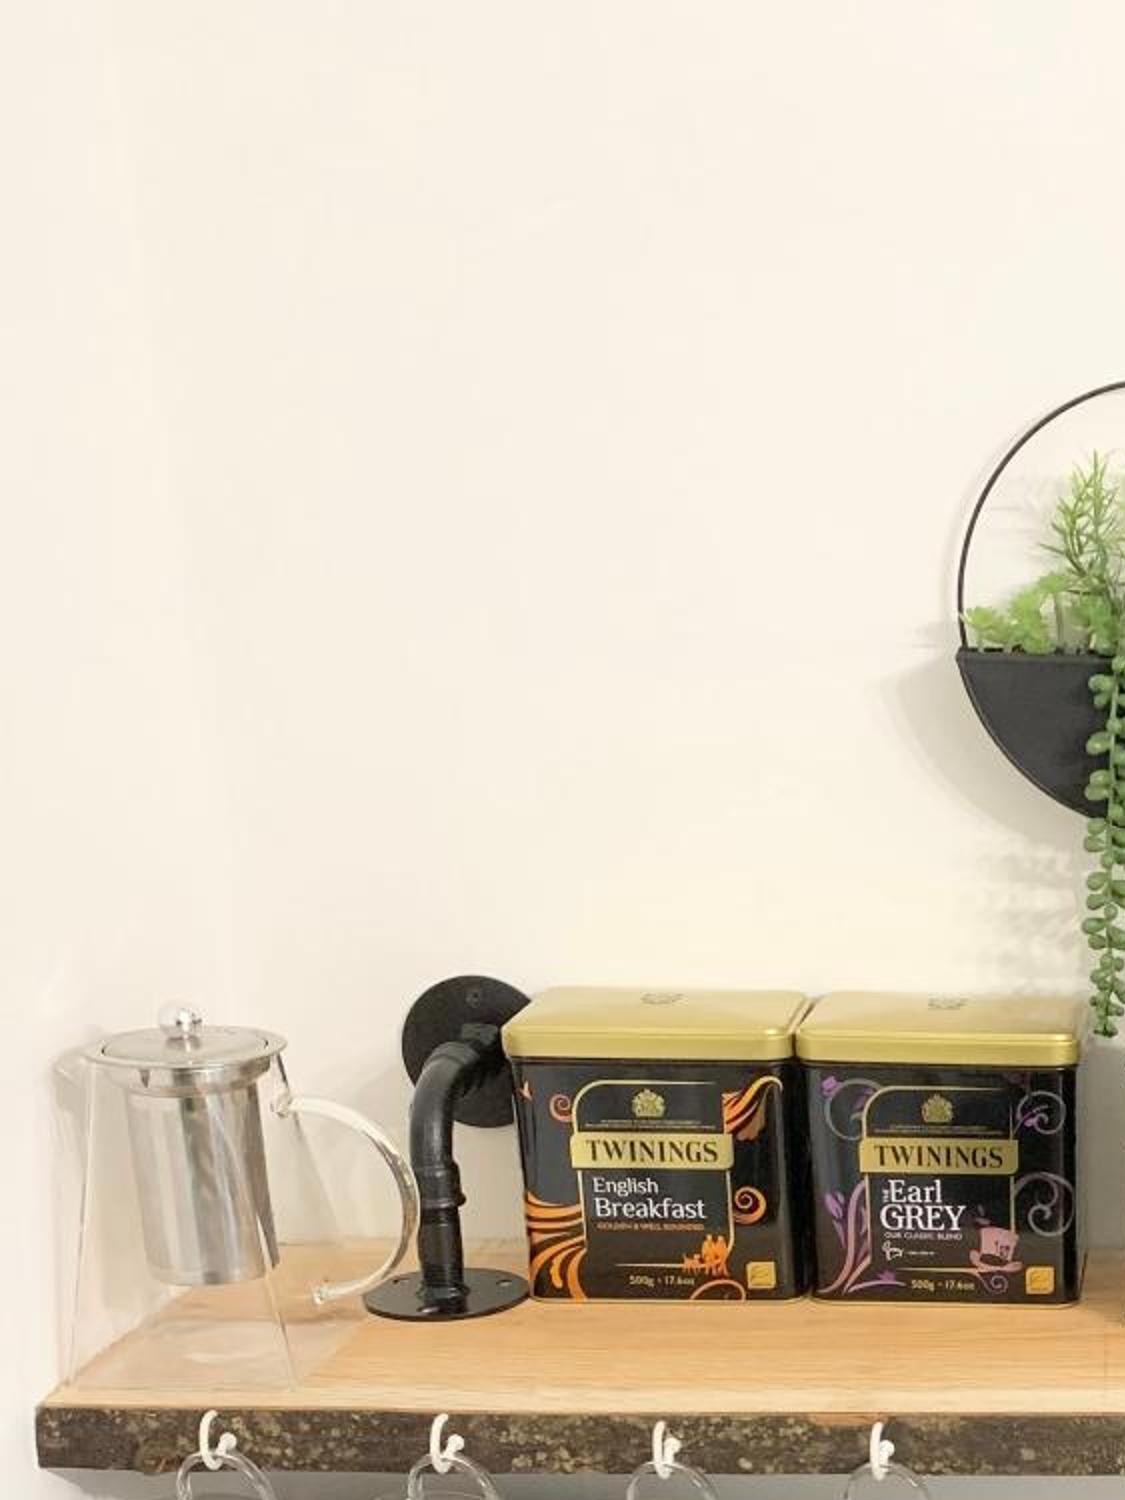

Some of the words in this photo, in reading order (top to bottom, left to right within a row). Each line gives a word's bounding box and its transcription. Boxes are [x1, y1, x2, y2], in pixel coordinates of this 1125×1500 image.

[586, 1139, 719, 1163] TWININGS
[873, 1145, 1003, 1169] TWININGS
[592, 1177, 659, 1198] English
[888, 1179, 943, 1203] Earl
[594, 1197, 708, 1219] Breakfast
[879, 1203, 967, 1231] GREY
